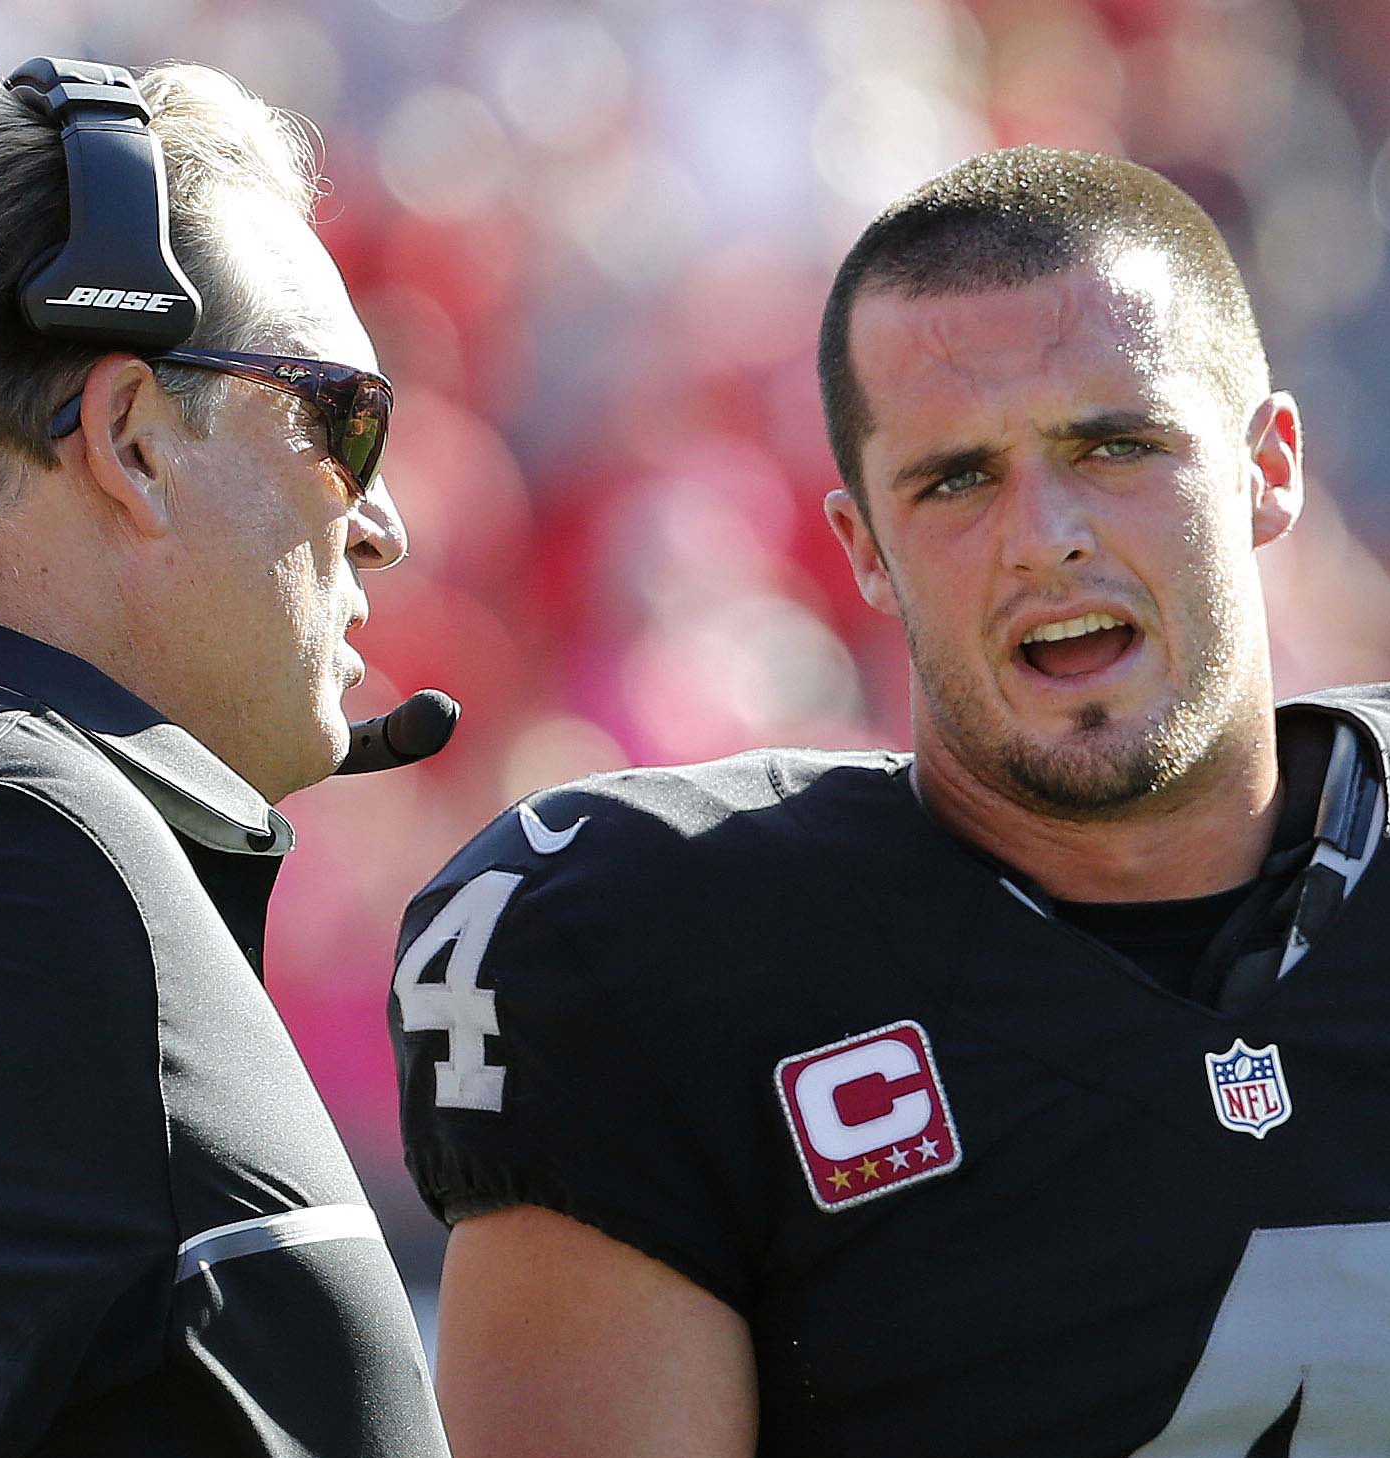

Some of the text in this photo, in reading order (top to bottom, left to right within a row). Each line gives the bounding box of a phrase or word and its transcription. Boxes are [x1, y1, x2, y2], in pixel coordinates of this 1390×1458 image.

[46, 287, 188, 313] BOSE
[392, 870, 524, 1112] 4
[795, 1039, 932, 1162] C
[1223, 1083, 1279, 1121] NFL
